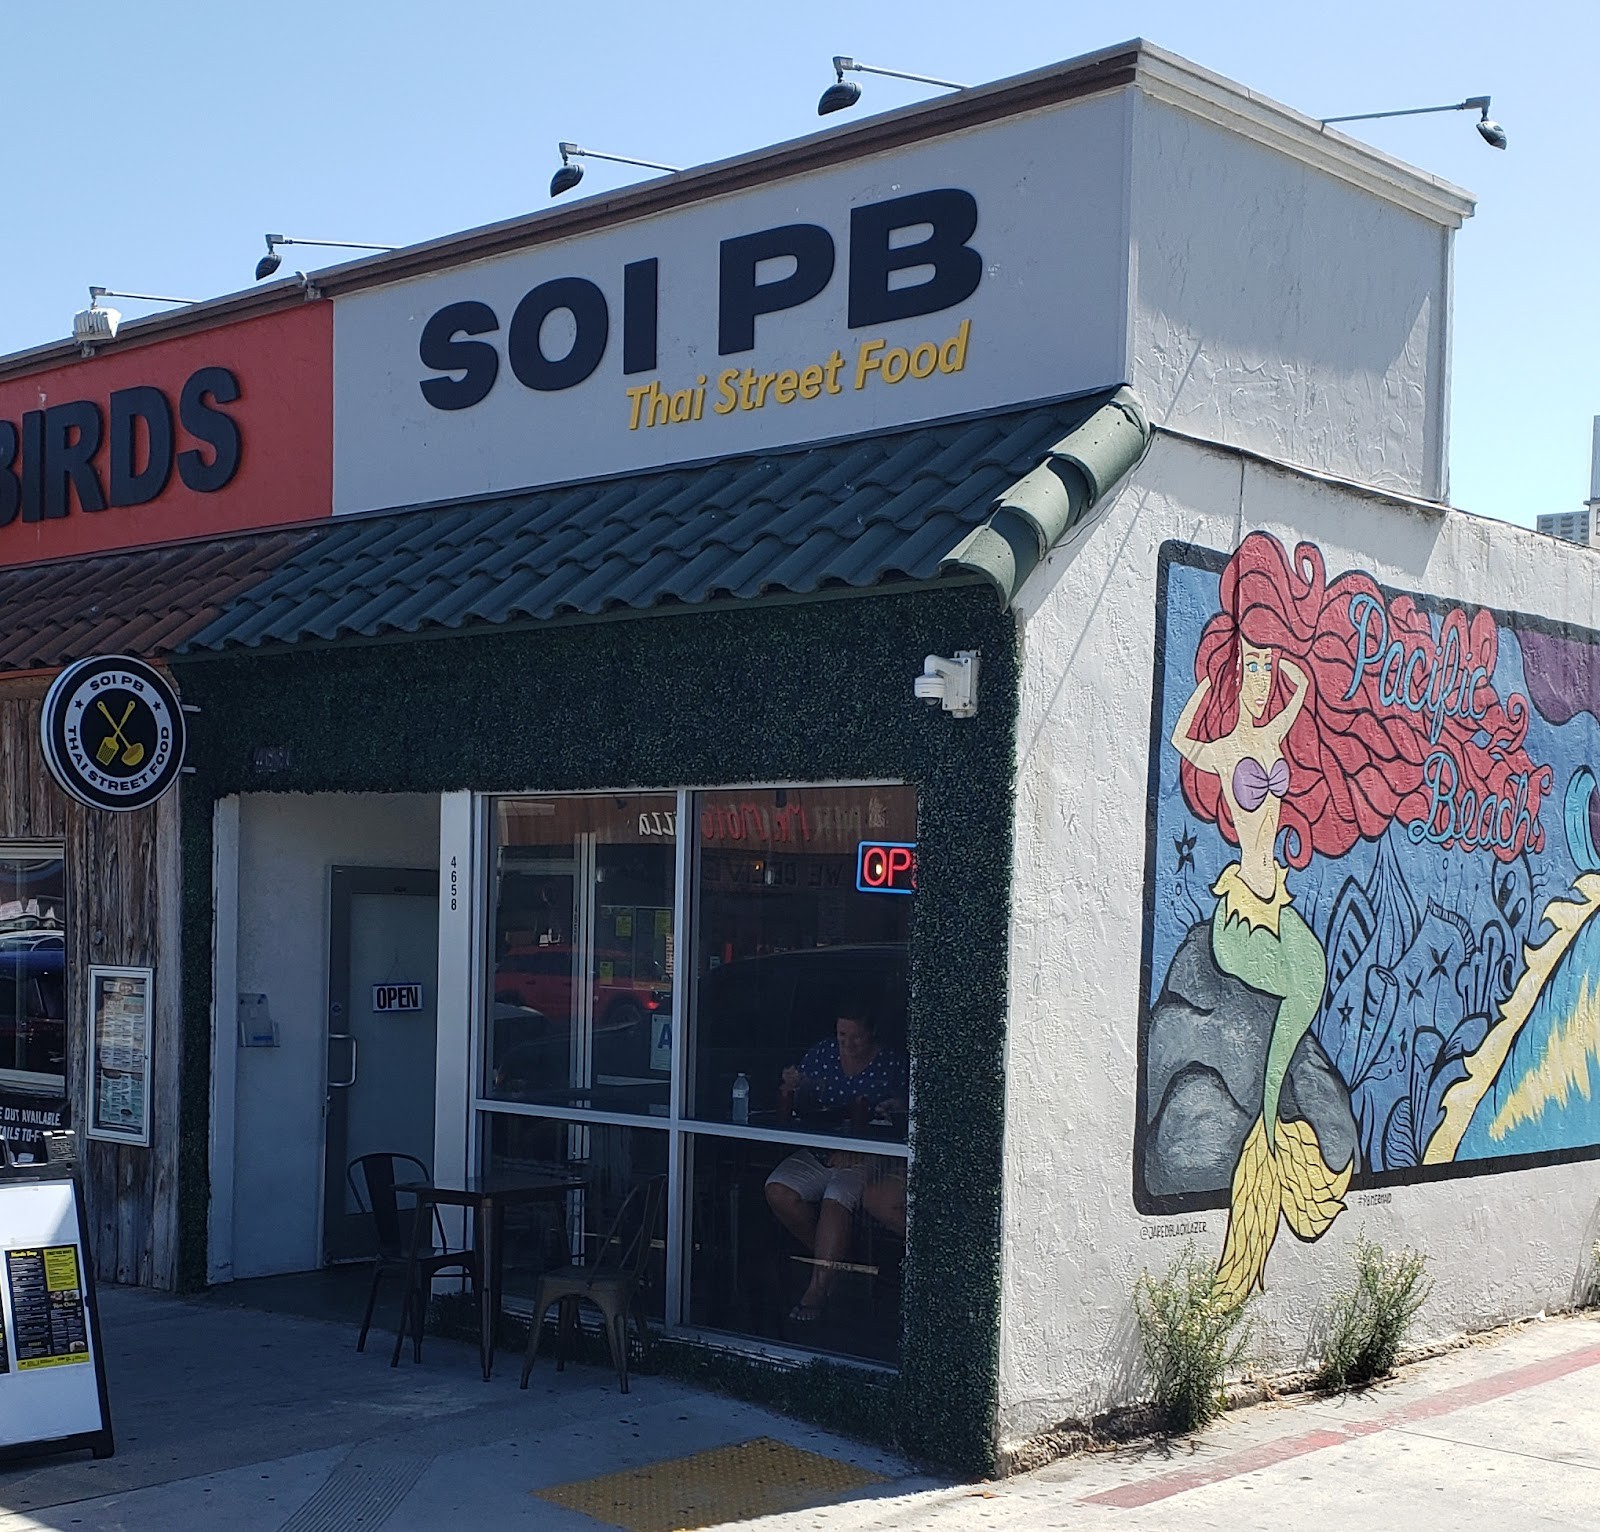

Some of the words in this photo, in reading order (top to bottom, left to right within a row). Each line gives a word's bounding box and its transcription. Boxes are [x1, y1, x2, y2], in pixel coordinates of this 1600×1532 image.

[419, 257, 657, 411] SOI
[718, 188, 983, 356] PB
[626, 374, 705, 430] Thai
[712, 350, 845, 415] Street
[854, 318, 972, 389] Food
[90, 674, 117, 691] SOI
[121, 675, 145, 692] PB
[1343, 593, 1489, 746] Pacific
[68, 725, 89, 771] THAI
[87, 770, 149, 791] STREET
[149, 726, 170, 775] FOOD
[1407, 752, 1535, 854] Beach
[376, 986, 419, 1010] OPEN
[4, 1107, 20, 1122] OUT
[22, 1109, 62, 1126] AVAILABLE
